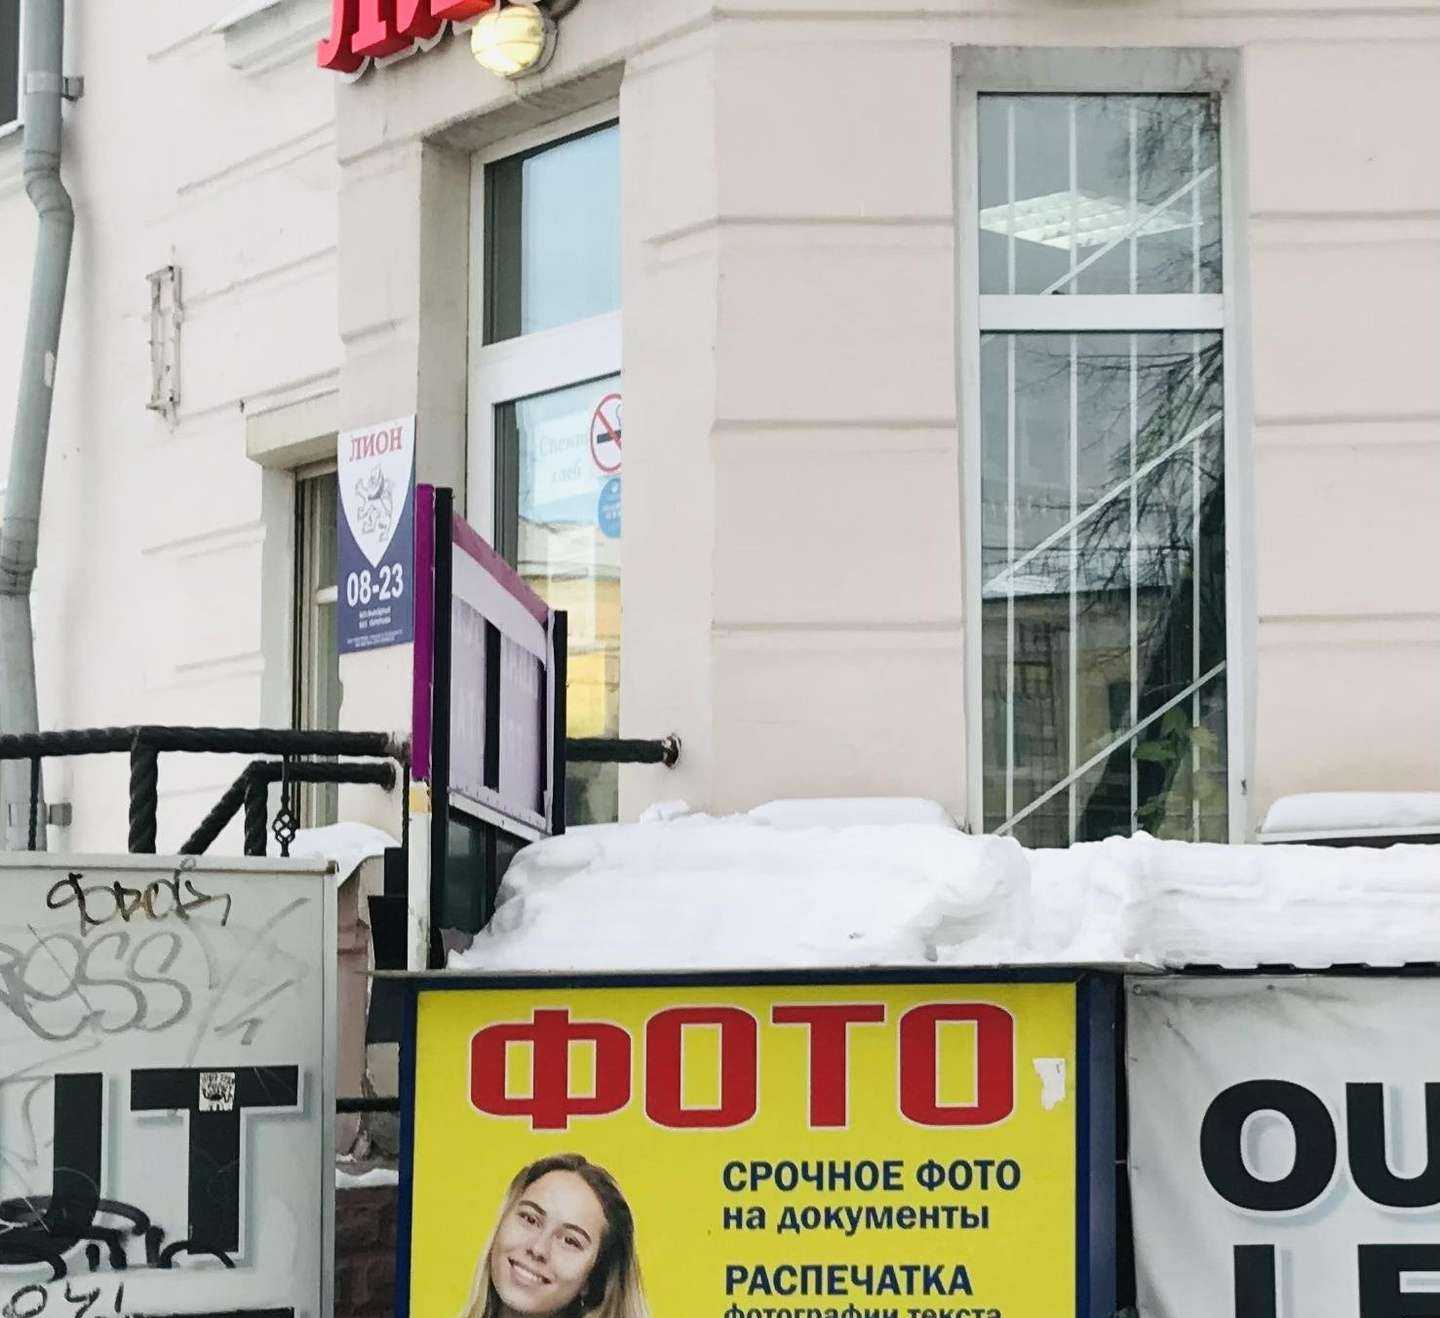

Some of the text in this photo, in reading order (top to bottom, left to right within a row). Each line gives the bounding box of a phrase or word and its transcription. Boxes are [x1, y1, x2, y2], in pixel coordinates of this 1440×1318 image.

[349, 426, 403, 463] ЛИОН
[346, 562, 404, 607] 08-23
[469, 1002, 1015, 1132] ФОТО
[722, 1159, 1021, 1192] СРОЧНОЕ ФОТО
[723, 1205, 989, 1237] на документы
[725, 1264, 973, 1296] РАСПЕЧАТКА
